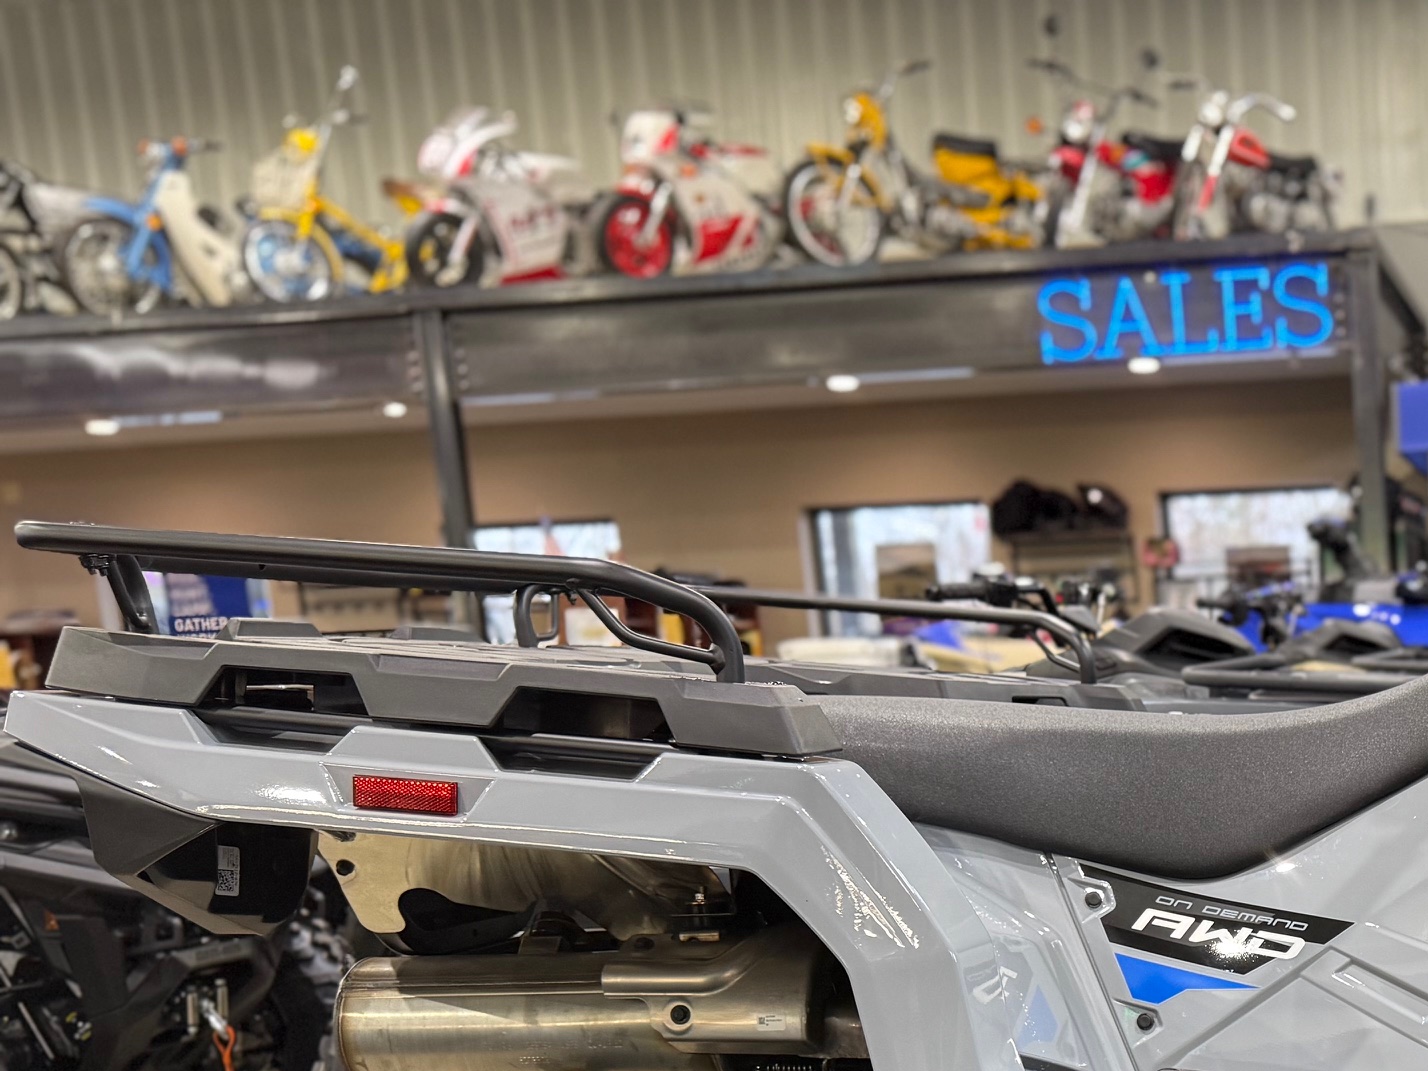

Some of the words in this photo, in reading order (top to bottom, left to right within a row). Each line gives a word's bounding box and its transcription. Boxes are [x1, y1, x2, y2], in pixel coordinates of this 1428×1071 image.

[1037, 262, 1333, 365] SALES
[1131, 907, 1306, 960] AWD
[1155, 895, 1193, 910] ON
[1202, 905, 1309, 932] DEMAND
